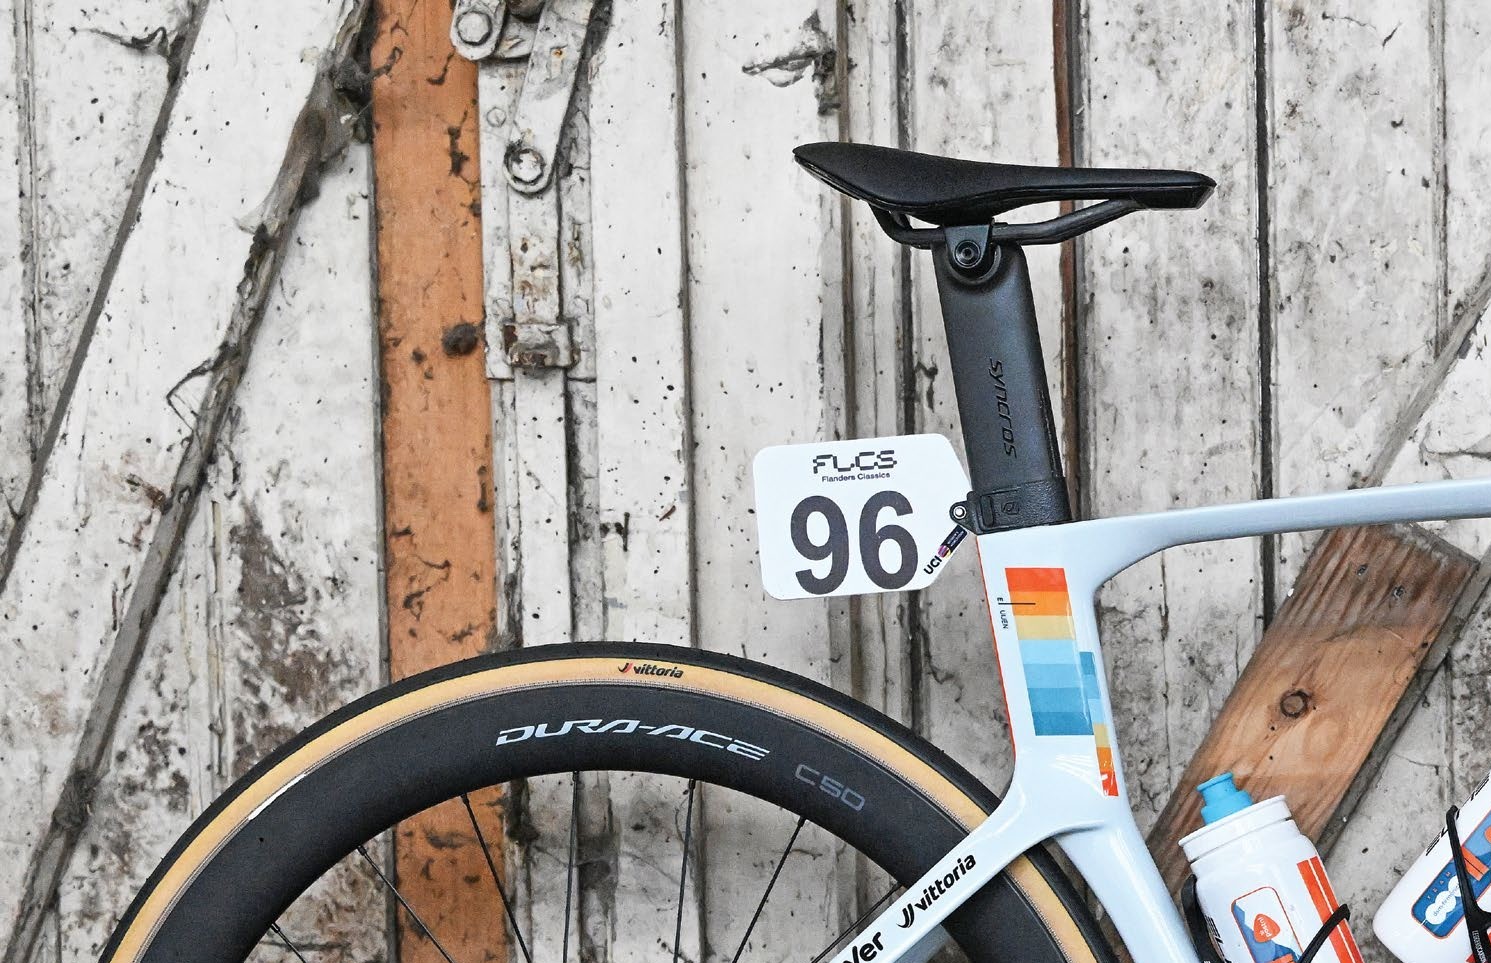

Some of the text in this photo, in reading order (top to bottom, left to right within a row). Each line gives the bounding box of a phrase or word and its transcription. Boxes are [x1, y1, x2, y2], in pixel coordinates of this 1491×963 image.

[821, 471, 891, 483] Flanders Classics
[790, 490, 919, 595] 96
[923, 555, 943, 575] UCI
[633, 665, 684, 679] vittoria
[495, 718, 866, 812] DURA-ACE C50
[914, 854, 977, 911] vittoria
